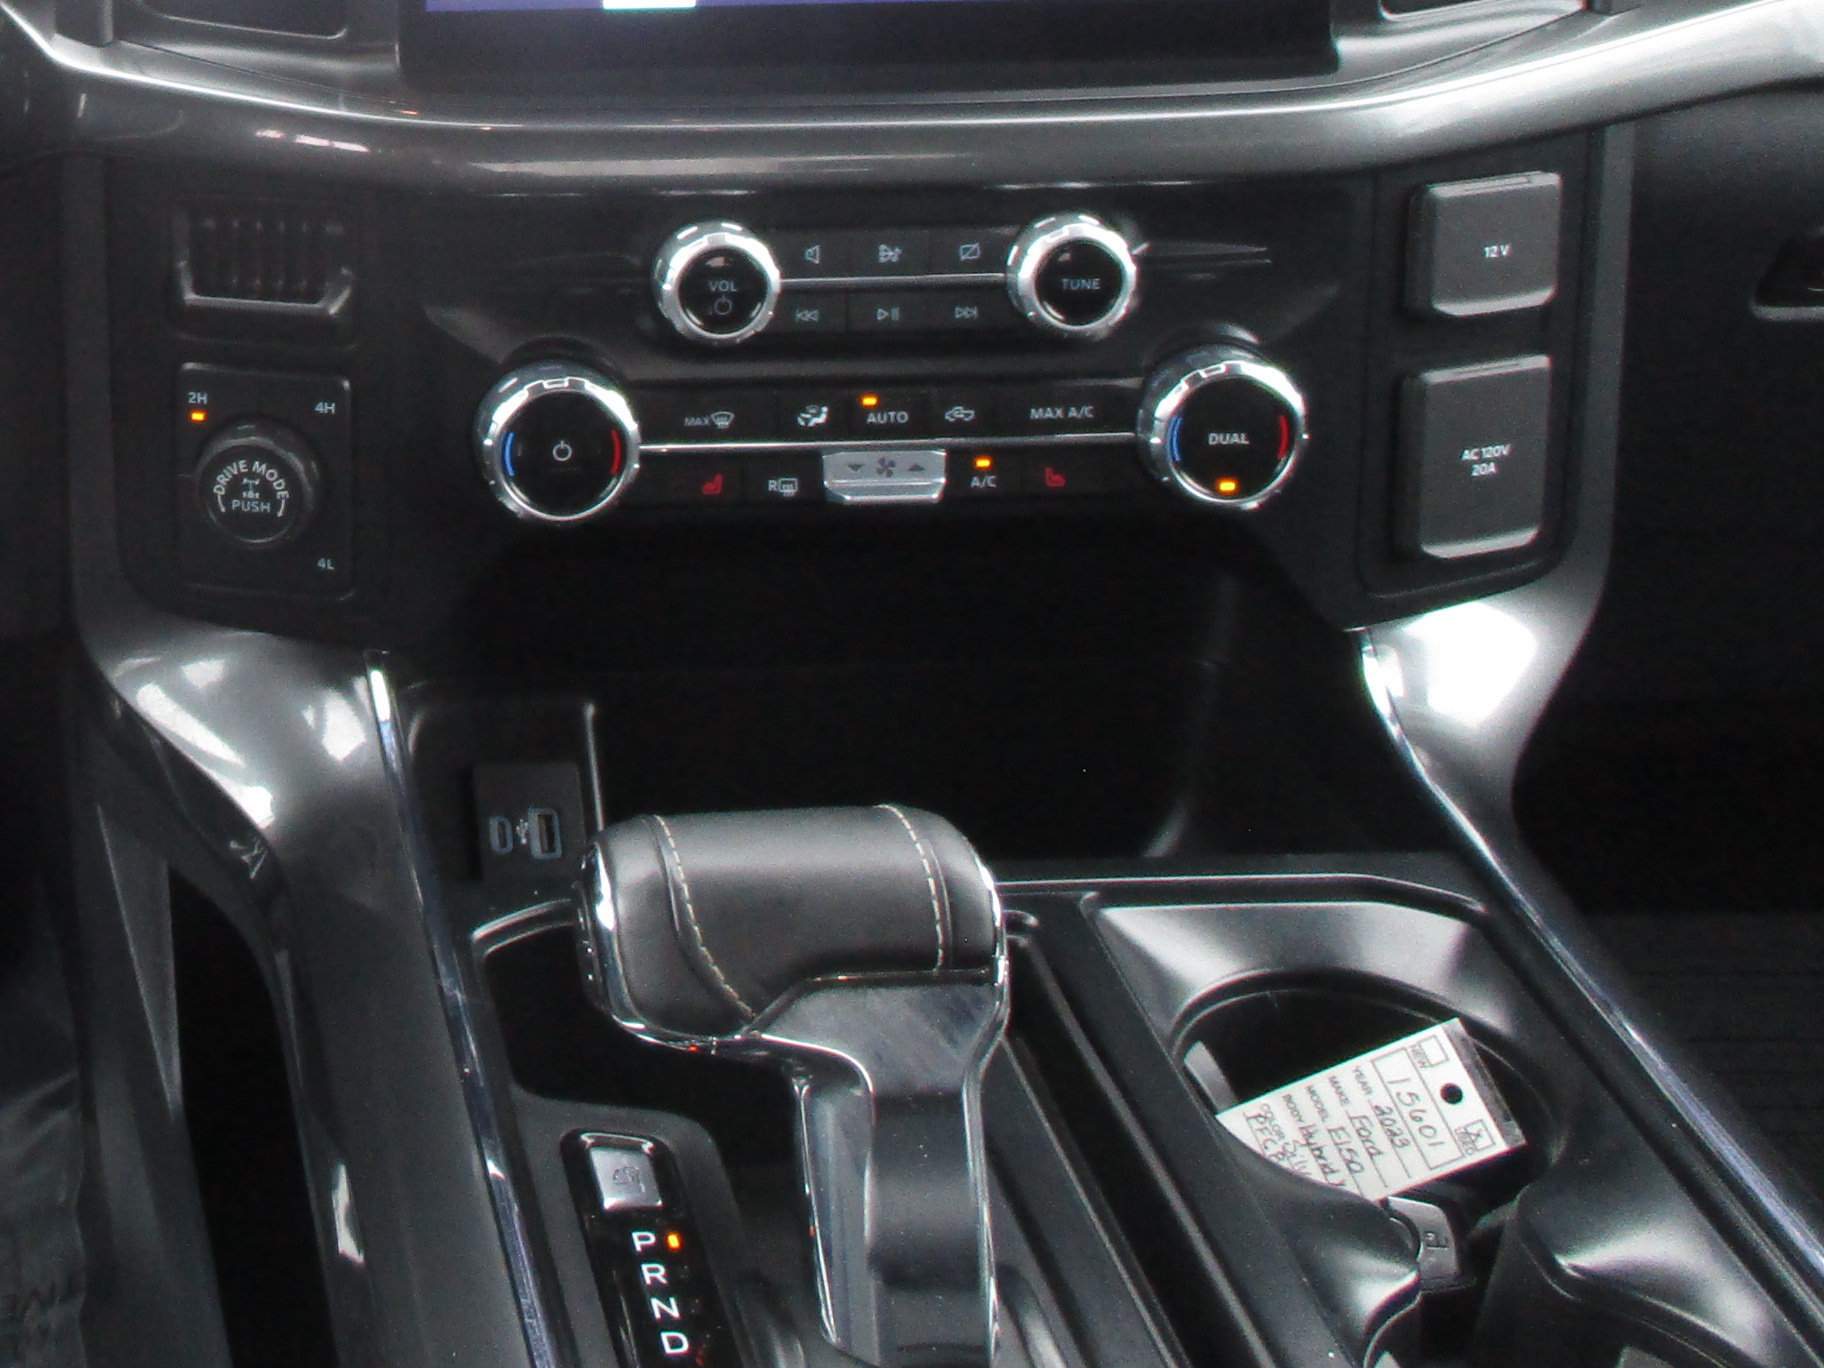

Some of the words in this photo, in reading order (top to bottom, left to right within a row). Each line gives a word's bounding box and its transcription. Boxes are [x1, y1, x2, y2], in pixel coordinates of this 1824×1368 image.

[707, 280, 738, 293] VOL
[1060, 277, 1102, 291] TUNE
[187, 391, 209, 405] 2H
[314, 401, 337, 416] 4H
[1029, 407, 1065, 420] MAX
[1067, 405, 1095, 420] A/C
[684, 415, 711, 428] MAX
[865, 410, 910, 425] AUTO
[1207, 431, 1251, 446] DUAL
[1460, 447, 1481, 461] AC
[1471, 462, 1497, 477] 20A
[213, 460, 250, 497] DRIVE
[251, 460, 291, 500] MODE
[970, 474, 997, 489] A/C
[231, 498, 272, 513] PUSH
[316, 557, 336, 571] 4L
[1282, 1093, 1304, 1123] BODY
[1306, 1084, 1329, 1122] MODEL
[1353, 1065, 1374, 1095] YEAR
[1372, 1104, 1412, 1148] 2023
[1328, 1075, 1350, 1106] MAKE
[1348, 1115, 1384, 1157] Ford
[1388, 1078, 1445, 1147] 15601
[631, 1230, 656, 1253] P
[640, 1263, 668, 1285] R
[649, 1296, 681, 1320] N
[659, 1330, 690, 1356] D
